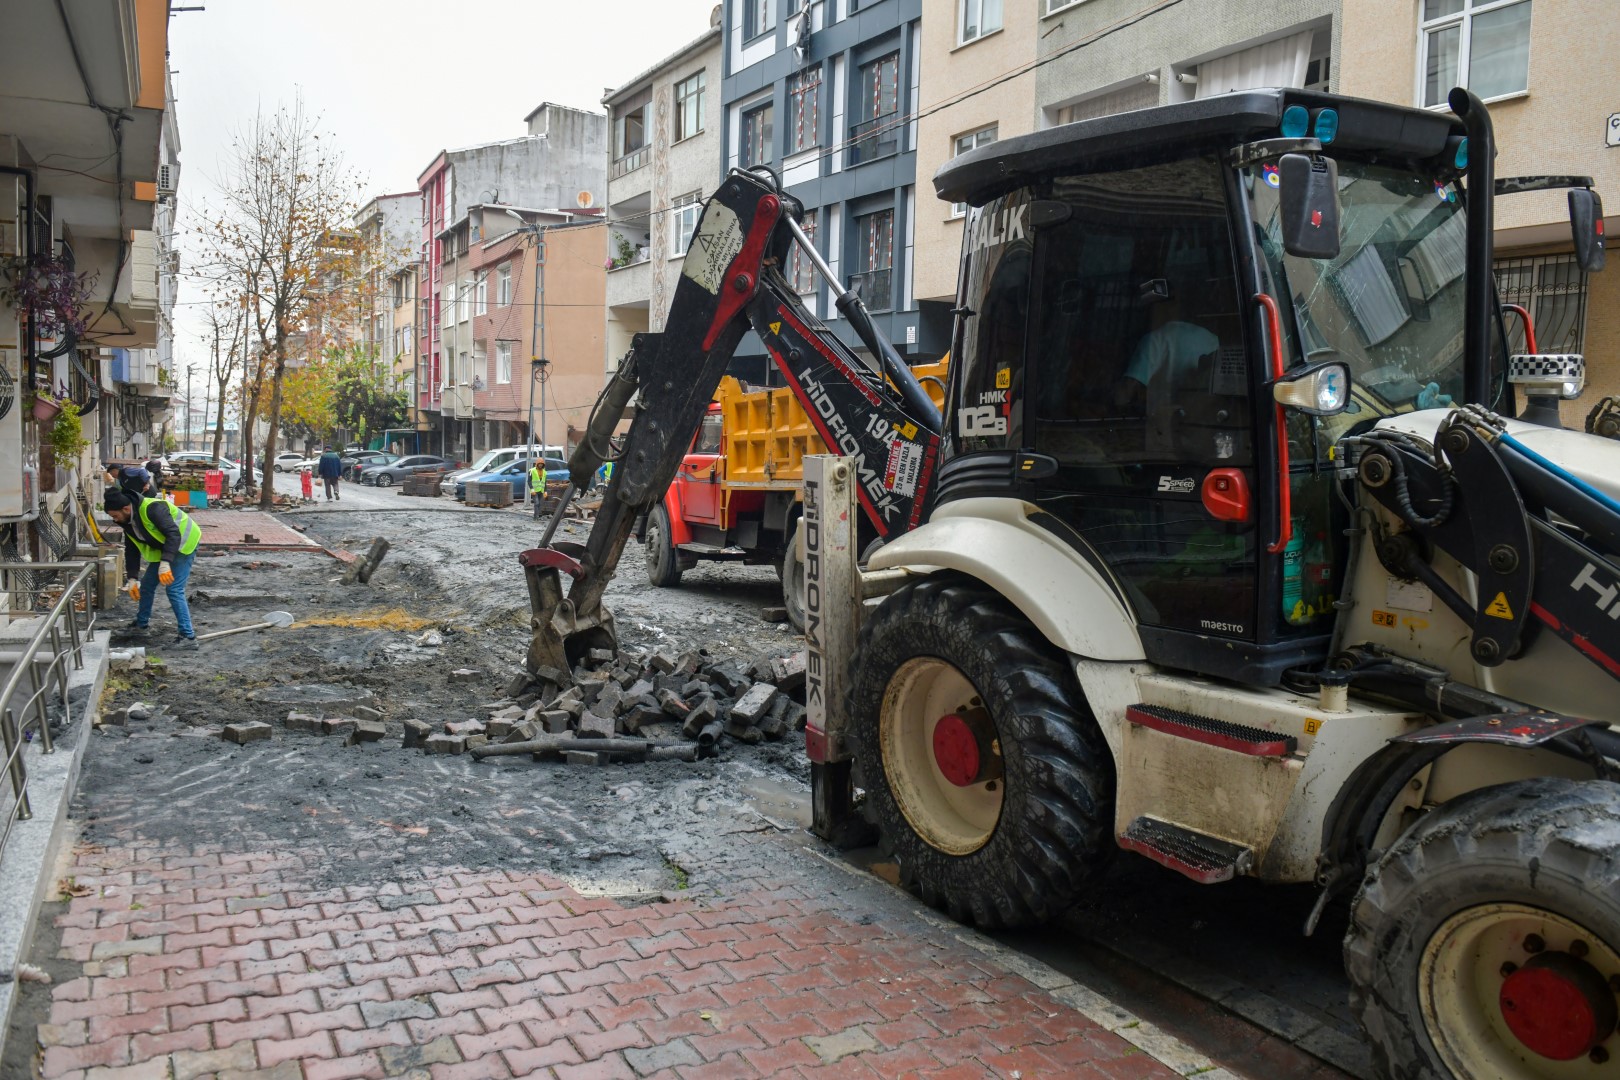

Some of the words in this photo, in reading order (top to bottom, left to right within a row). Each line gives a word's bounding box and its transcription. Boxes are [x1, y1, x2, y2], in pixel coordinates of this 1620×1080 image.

[980, 390, 1007, 405] HMK
[865, 413, 899, 450] 194
[901, 445, 911, 463] FAZLA
[898, 461, 907, 475] DEN
[1200, 619, 1244, 633] maestro
